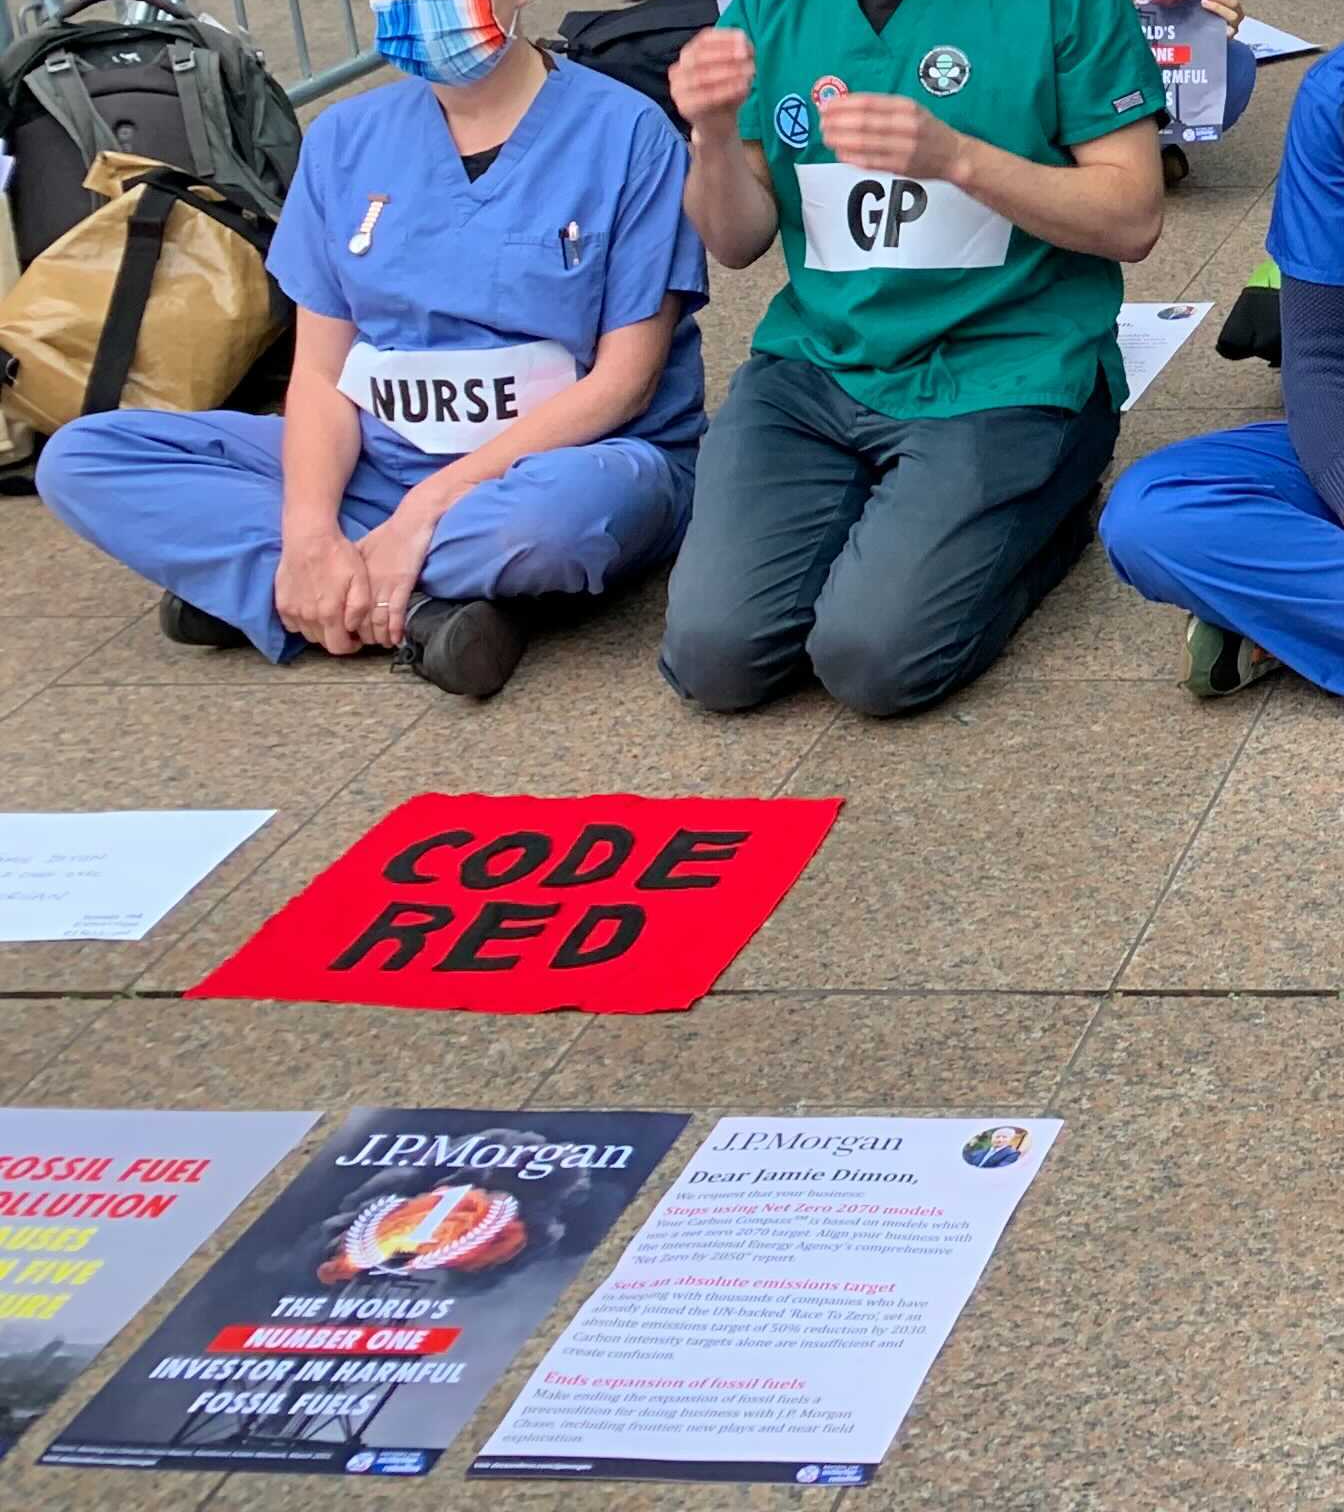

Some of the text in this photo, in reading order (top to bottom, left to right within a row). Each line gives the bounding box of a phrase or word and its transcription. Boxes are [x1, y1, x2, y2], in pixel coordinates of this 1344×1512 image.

[1142, 25, 1176, 39] LD'S
[1163, 70, 1208, 84] RMFUL
[847, 178, 928, 251] GP
[370, 375, 519, 423] NURSE
[381, 824, 751, 890] CODE
[328, 901, 648, 973] RED
[335, 1133, 636, 1179] J.P.Morgan
[713, 1131, 905, 1157] J.P.Morgan
[119, 1158, 211, 1183] FUEL
[688, 1168, 919, 1185] Dear Jamie Dimon,
[0, 1192, 178, 1218] OLLUTION
[405, 1183, 474, 1244] 1
[664, 1203, 944, 1218] Stops using Net Zero 2070 models
[0, 1227, 98, 1251] AUSES
[15, 1260, 104, 1285] FIVE
[650, 1278, 671, 1287] an
[674, 1276, 750, 1287] absolute
[753, 1279, 839, 1291] emissions
[843, 1282, 897, 1295] target
[270, 1297, 455, 1320] THE WORLD'S
[688, 1307, 710, 1315] the
[244, 1328, 429, 1351] NUMBER ONE
[149, 1357, 468, 1384] INVESTOR IN HARMFUL
[544, 1371, 806, 1389] Ends expansion of fossil fuels
[188, 1391, 379, 1417] FOSSIL FUELS
